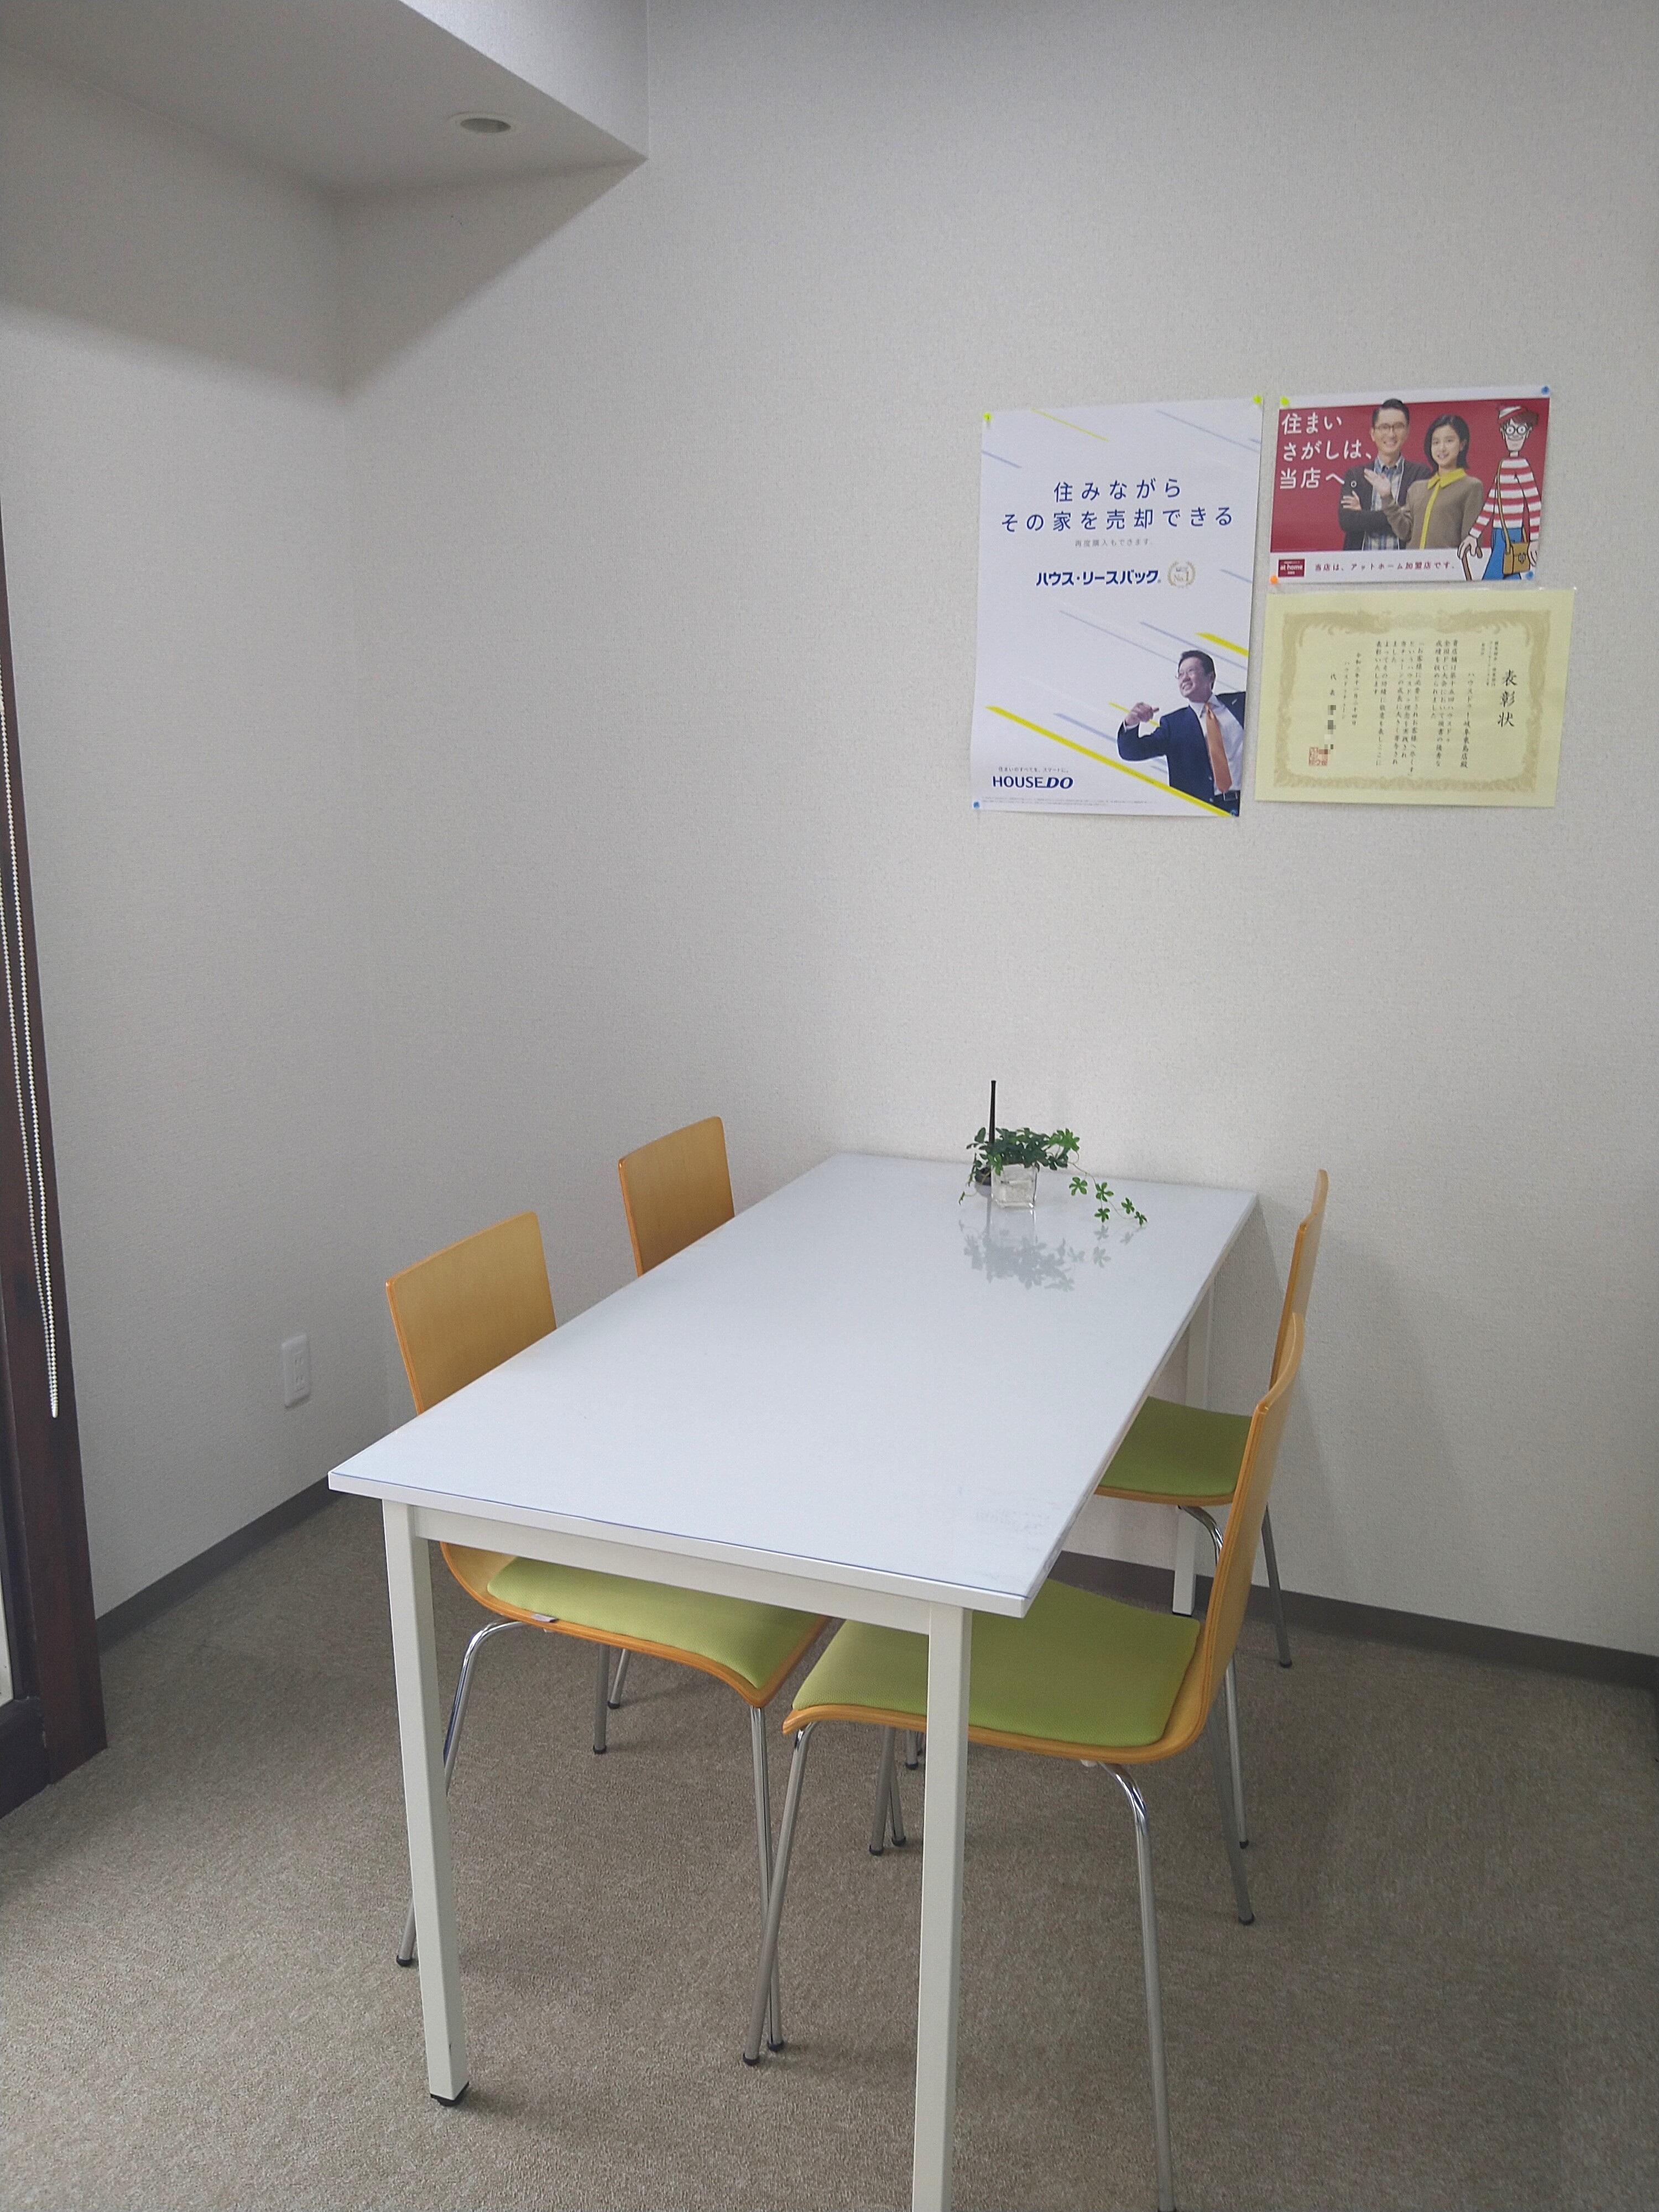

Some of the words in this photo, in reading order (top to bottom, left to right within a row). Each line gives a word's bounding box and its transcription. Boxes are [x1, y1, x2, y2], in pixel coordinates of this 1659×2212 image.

[1281, 412, 1343, 435] 住まい
[1282, 440, 1373, 462] さがしは、
[1279, 467, 1358, 489] 当店へ。
[1053, 478, 1181, 503] 住みながら
[1001, 506, 1233, 532] その家を売却できる
[1497, 669, 1518, 728] 表彰状
